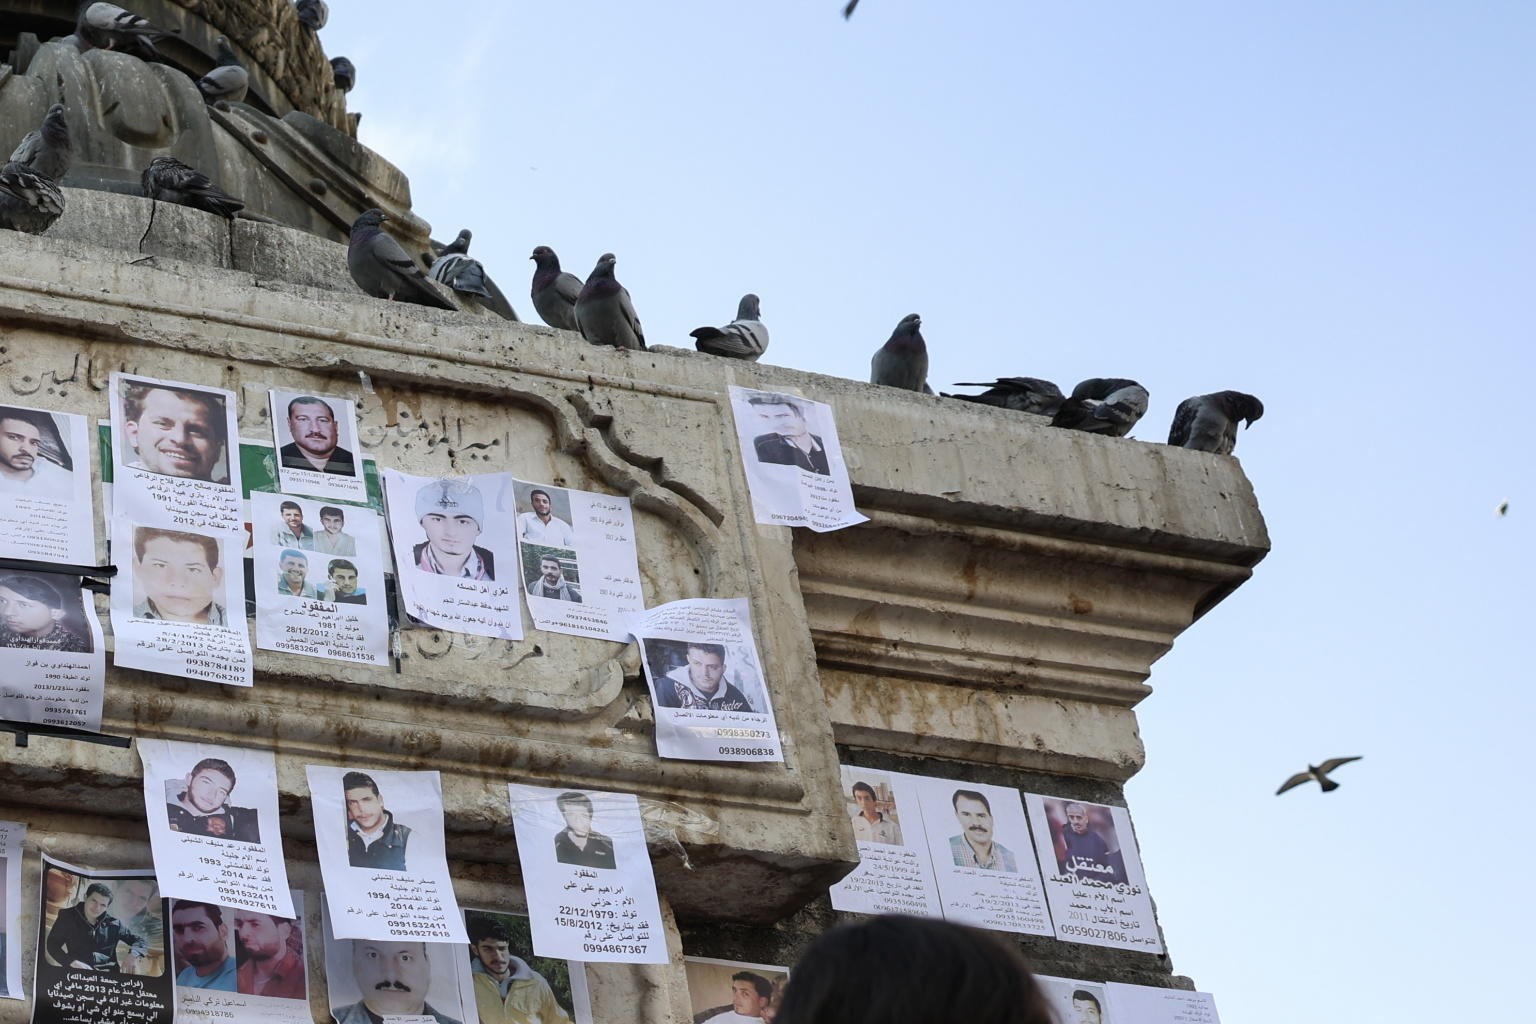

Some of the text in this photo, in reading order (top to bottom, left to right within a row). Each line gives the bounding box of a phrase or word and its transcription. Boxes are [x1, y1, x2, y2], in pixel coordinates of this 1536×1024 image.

[152, 493, 172, 503] 1991
[173, 515, 195, 526] 2012
[301, 601, 338, 613] المفقود
[318, 621, 336, 629] 1981
[286, 625, 329, 638] 28/12/2012
[275, 641, 375, 661] 0968631536 099583266
[186, 657, 246, 674] 0938784189
[186, 666, 246, 683] 0940768202
[718, 746, 775, 756] 0938906838
[199, 857, 221, 866] 1993
[1066, 855, 1114, 874] معتقل
[221, 869, 244, 879] 2014
[574, 869, 598, 878] المفقود
[1050, 874, 1141, 896] نوري محمد العبد
[218, 885, 274, 903] 0991532411
[367, 891, 390, 900] 1994
[390, 902, 414, 910] 2014
[1069, 902, 1092, 910] محمد
[622, 909, 637, 920] تولد
[1067, 909, 1089, 922] 2011
[387, 920, 447, 929] 0991532411
[554, 917, 649, 931] فقد 15/8/2012
[1119, 920, 1140, 930] تاريخ
[584, 930, 597, 941] رقم
[617, 932, 650, 942] للتواصل
[1060, 924, 1128, 943] 0959027806
[583, 943, 647, 954] 0994867367
[100, 976, 119, 986] جمعة
[47, 988, 74, 999] صيدنايا
[84, 984, 106, 993] 2013
[108, 986, 121, 995] عام
[122, 988, 134, 996] منذ
[136, 989, 157, 998] معتقل
[76, 994, 94, 1002] سجن
[96, 995, 107, 1005] في
[120, 998, 133, 1007] غير
[53, 1000, 76, 1011] يشوف
[134, 999, 164, 1009] معلومات
[86, 1005, 100, 1015] شي
[126, 1010, 145, 1019] يسمع
